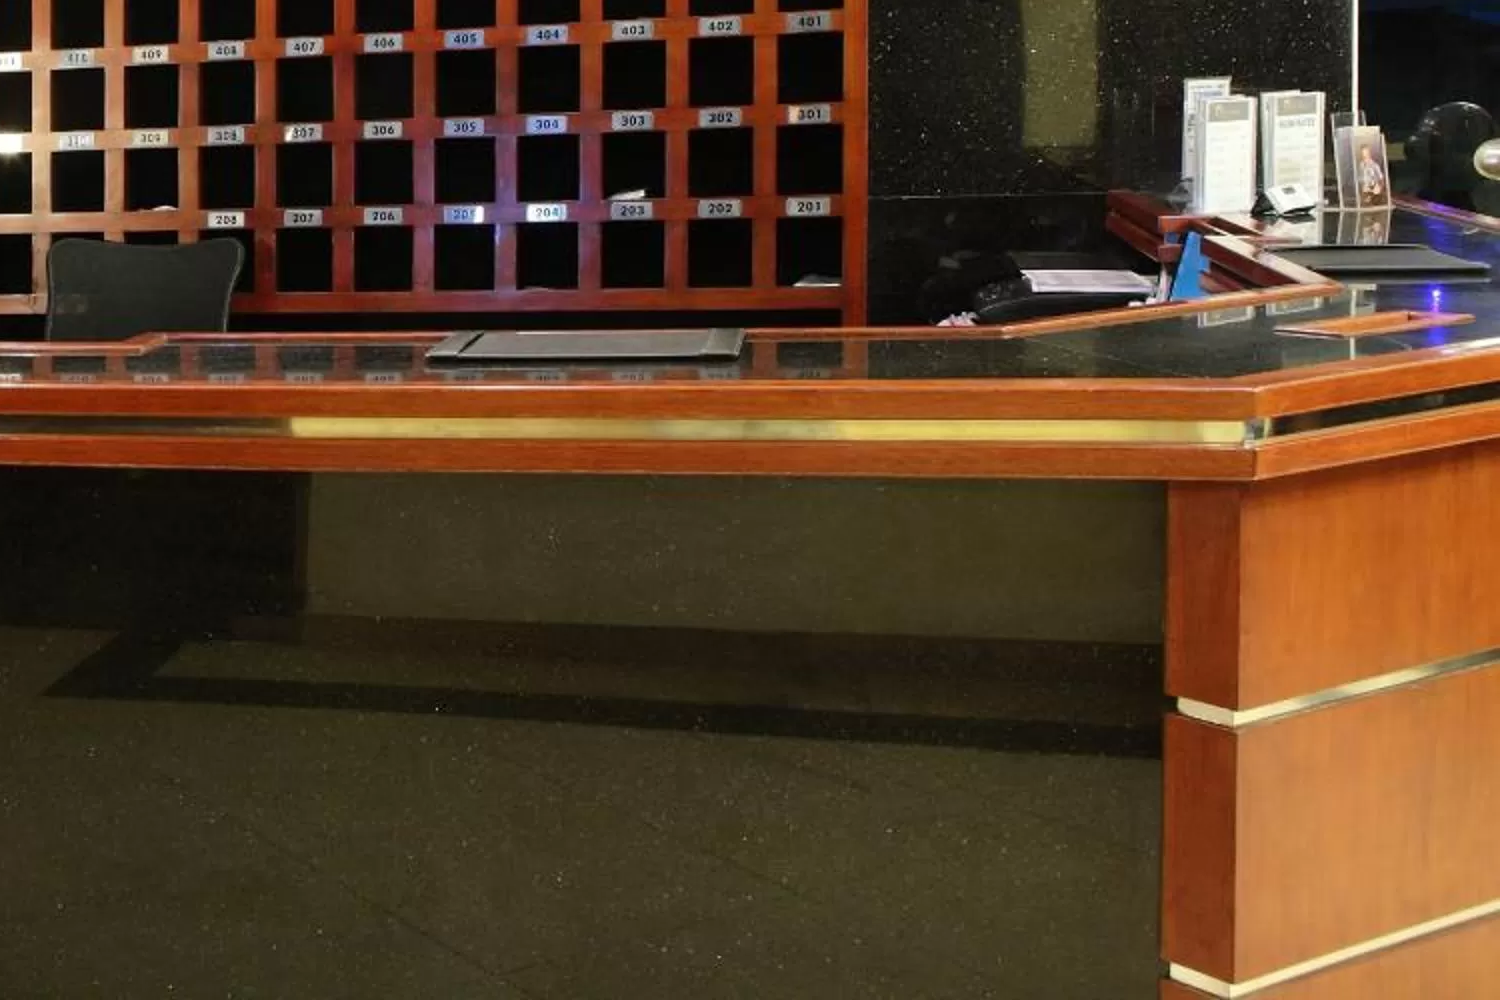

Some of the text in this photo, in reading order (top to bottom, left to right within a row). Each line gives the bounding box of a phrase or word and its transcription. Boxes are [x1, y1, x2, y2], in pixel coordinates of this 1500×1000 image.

[708, 20, 734, 32] 402
[799, 15, 822, 28] 401
[535, 28, 560, 40] 404
[621, 25, 646, 36] 403
[372, 37, 395, 49] 406
[453, 33, 477, 44] 405
[293, 41, 316, 53] 407
[708, 111, 734, 123] 302
[799, 108, 822, 120] 301
[453, 121, 477, 133] 305
[535, 118, 560, 130] 304
[621, 115, 646, 127] 303
[292, 127, 315, 138] 307
[372, 124, 395, 136] 306
[620, 205, 645, 217] 203
[708, 202, 734, 214] 202
[797, 201, 822, 213] 201
[292, 212, 314, 224] 207
[372, 211, 395, 222] 206
